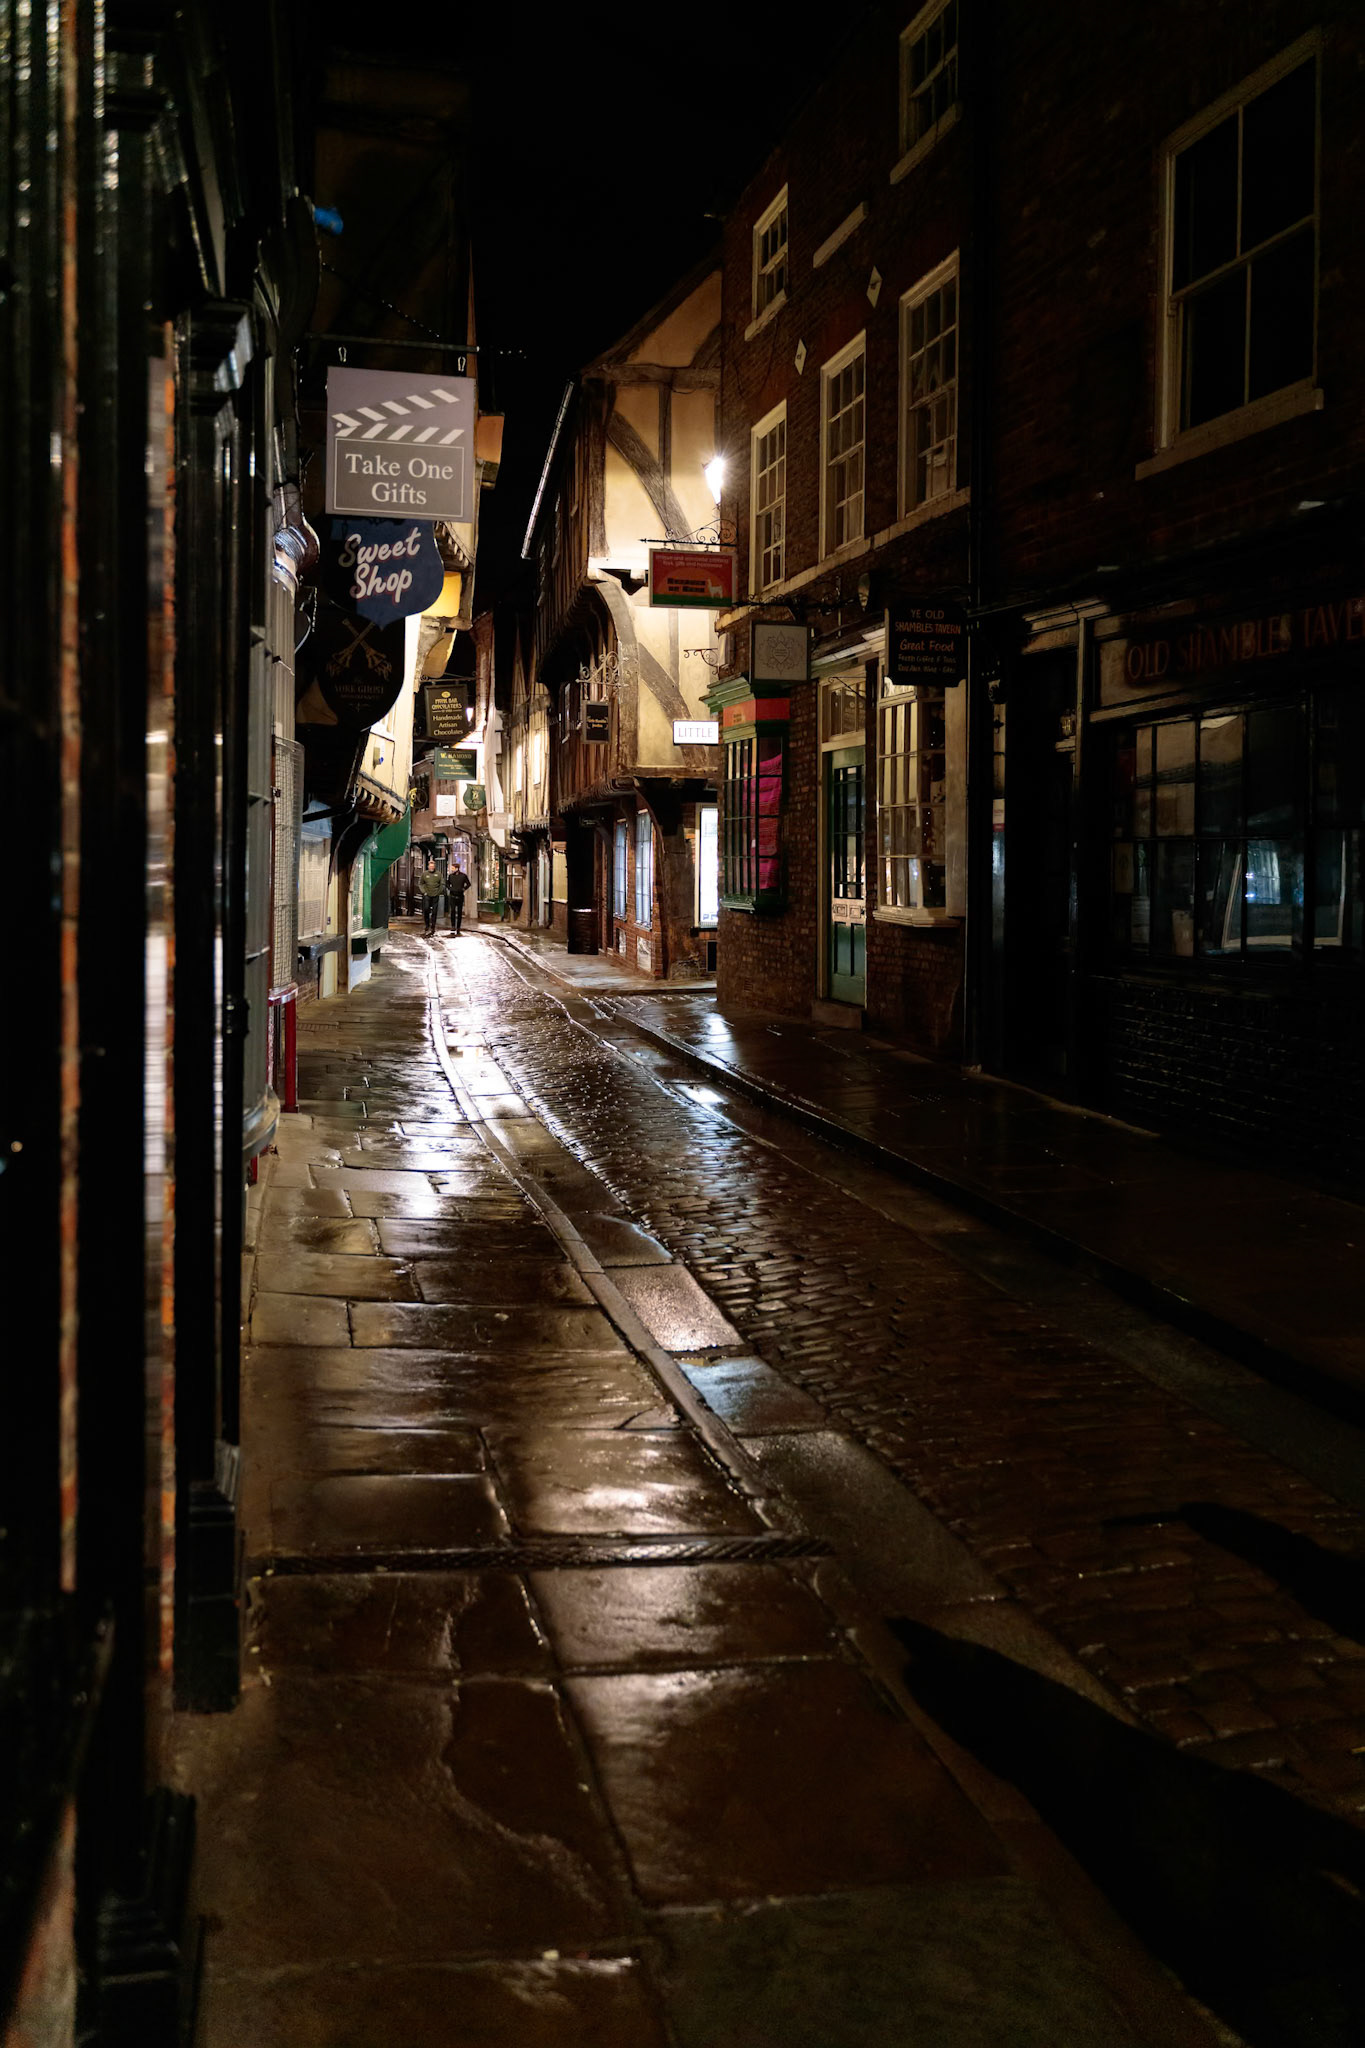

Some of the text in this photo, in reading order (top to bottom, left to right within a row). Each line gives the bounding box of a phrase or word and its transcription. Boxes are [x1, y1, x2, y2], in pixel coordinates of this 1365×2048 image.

[346, 453, 454, 480] Take One
[371, 482, 427, 505] Gifts
[337, 527, 421, 568] Sweet
[350, 563, 412, 603] Shop
[911, 609, 945, 620] YE OLD
[895, 621, 961, 635] SHAMBLES TAVERN
[1126, 595, 1365, 680] OLD SHAMBLES TAVE
[900, 639, 955, 652] Great Food
[678, 727, 713, 738] LITTLE
